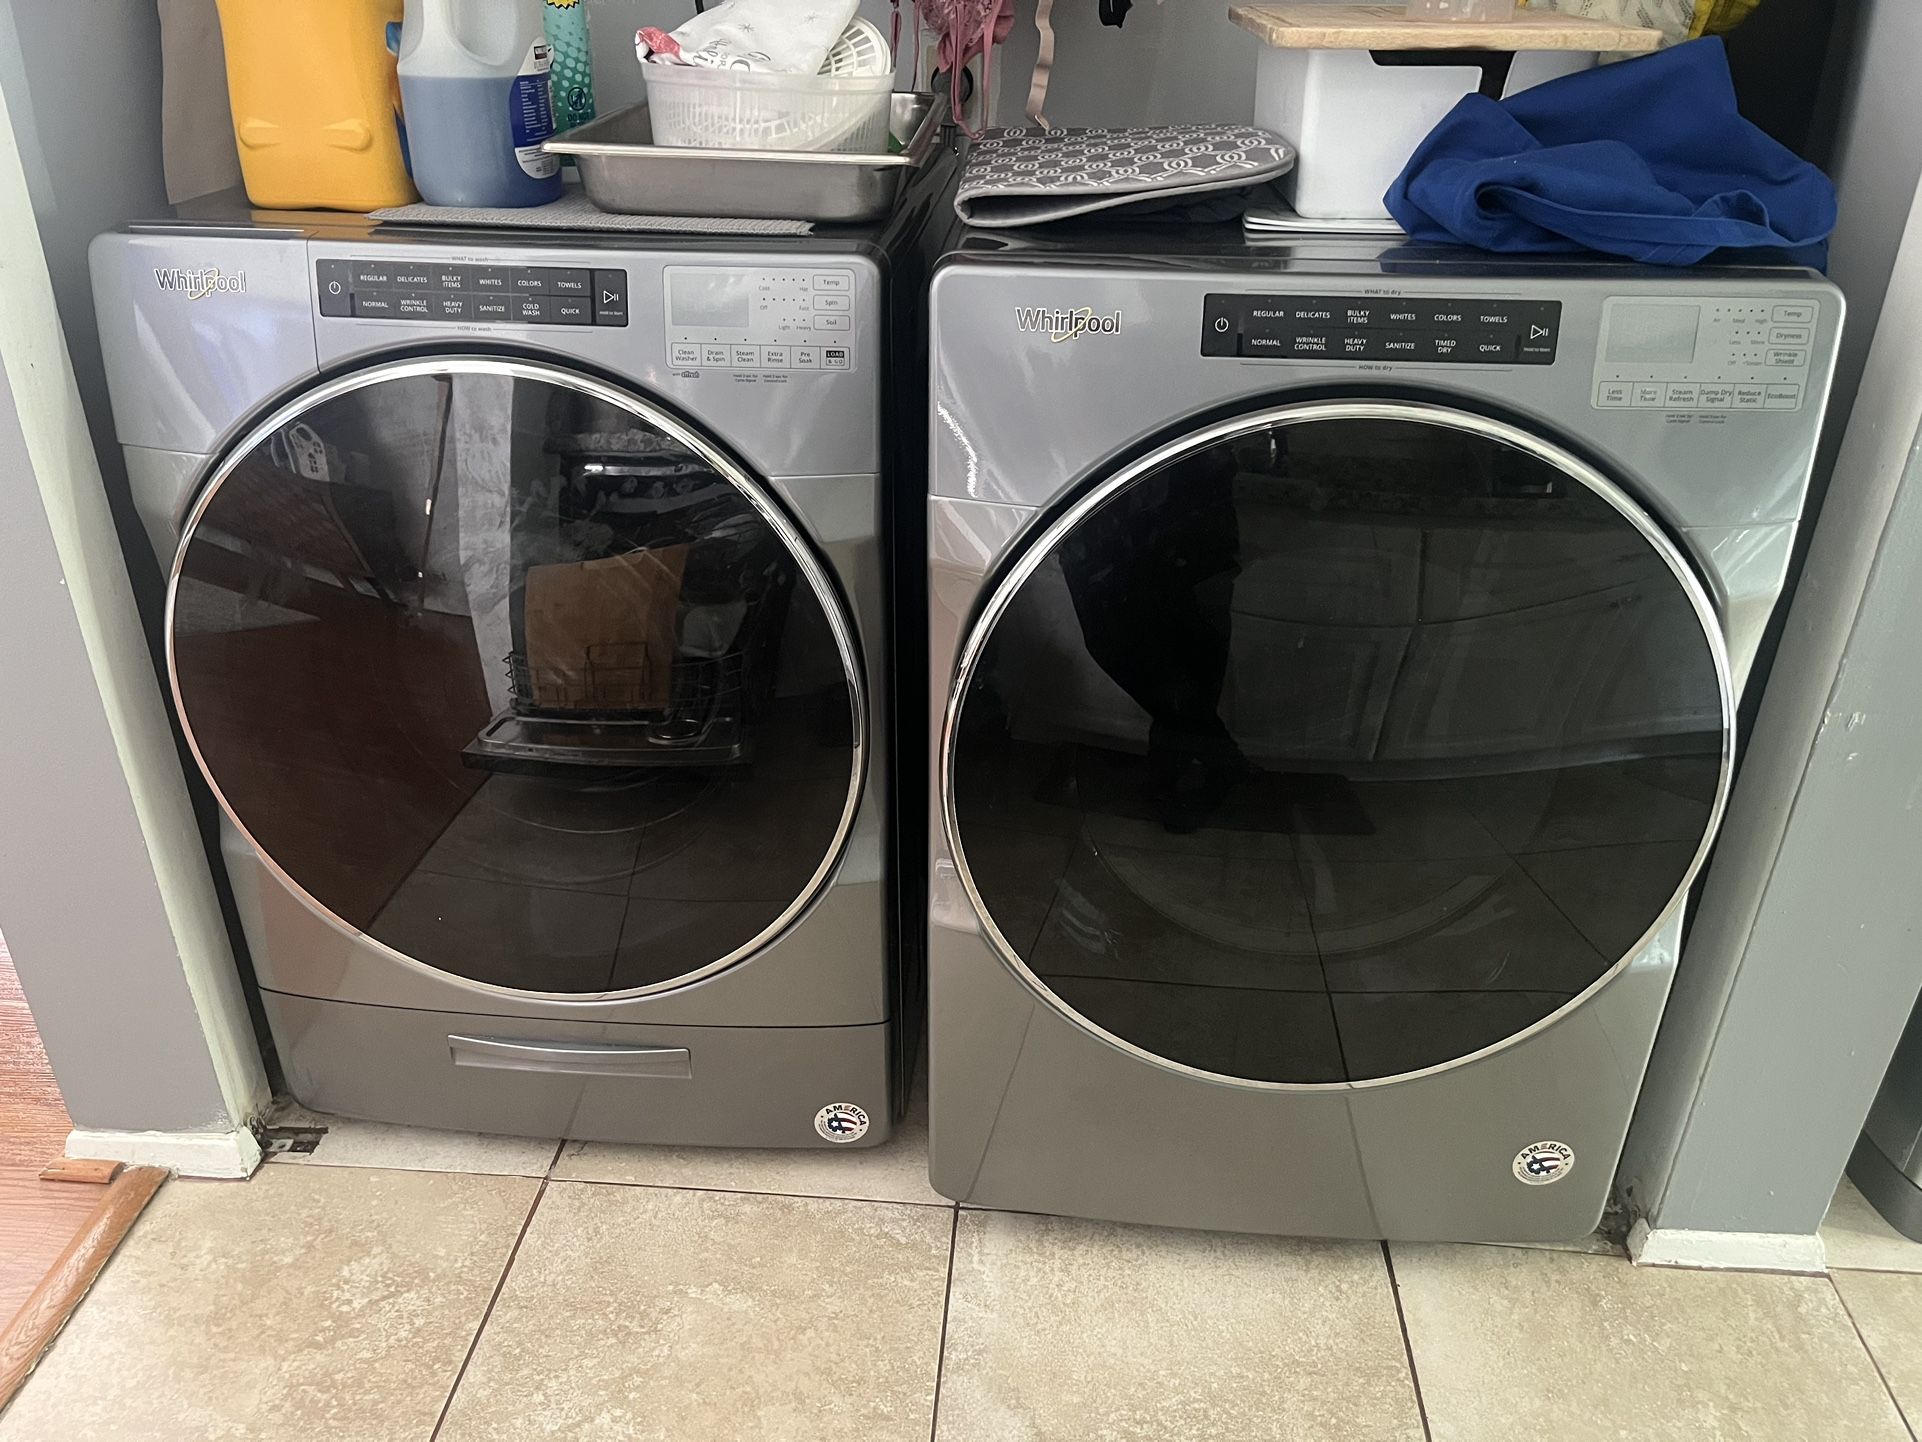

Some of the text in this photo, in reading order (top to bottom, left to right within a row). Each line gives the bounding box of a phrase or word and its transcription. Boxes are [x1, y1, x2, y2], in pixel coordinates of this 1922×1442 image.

[154, 268, 246, 300] Whirlpool
[1296, 311, 1330, 319] DELICATES
[1784, 310, 1802, 318] Temp
[1015, 306, 1122, 342] Whirlpool
[1721, 389, 1732, 397] Dry
[825, 1105, 866, 1126] AMERICA
[1521, 1143, 1571, 1160] AMERICA
